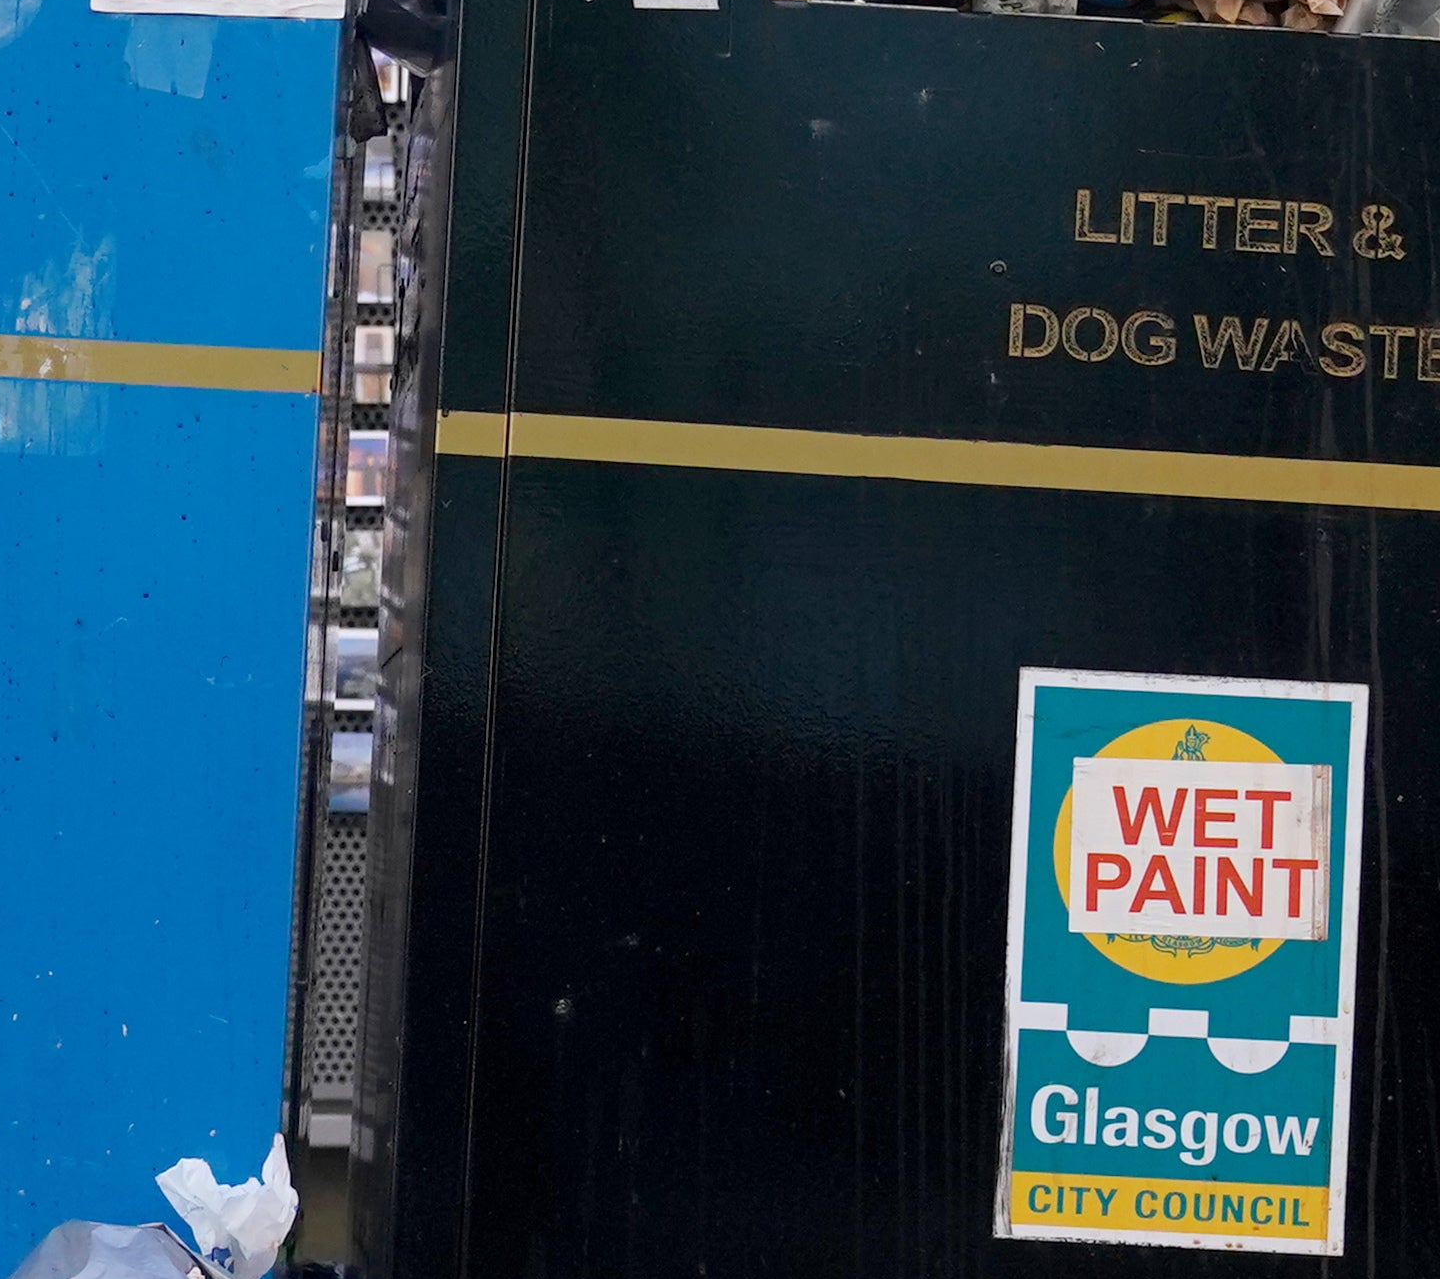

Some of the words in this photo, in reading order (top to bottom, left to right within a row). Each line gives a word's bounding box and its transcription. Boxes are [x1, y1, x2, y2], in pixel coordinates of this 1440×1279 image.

[1074, 188, 1335, 257] LITTER
[1353, 203, 1407, 260] &
[1007, 303, 1178, 366] DOG
[1113, 785, 1292, 850] WET
[1084, 852, 1319, 919] PAINT
[1030, 1083, 1320, 1167] Glasgow
[1028, 1184, 1118, 1217] CITY
[1134, 1188, 1310, 1227] COUNCIL
